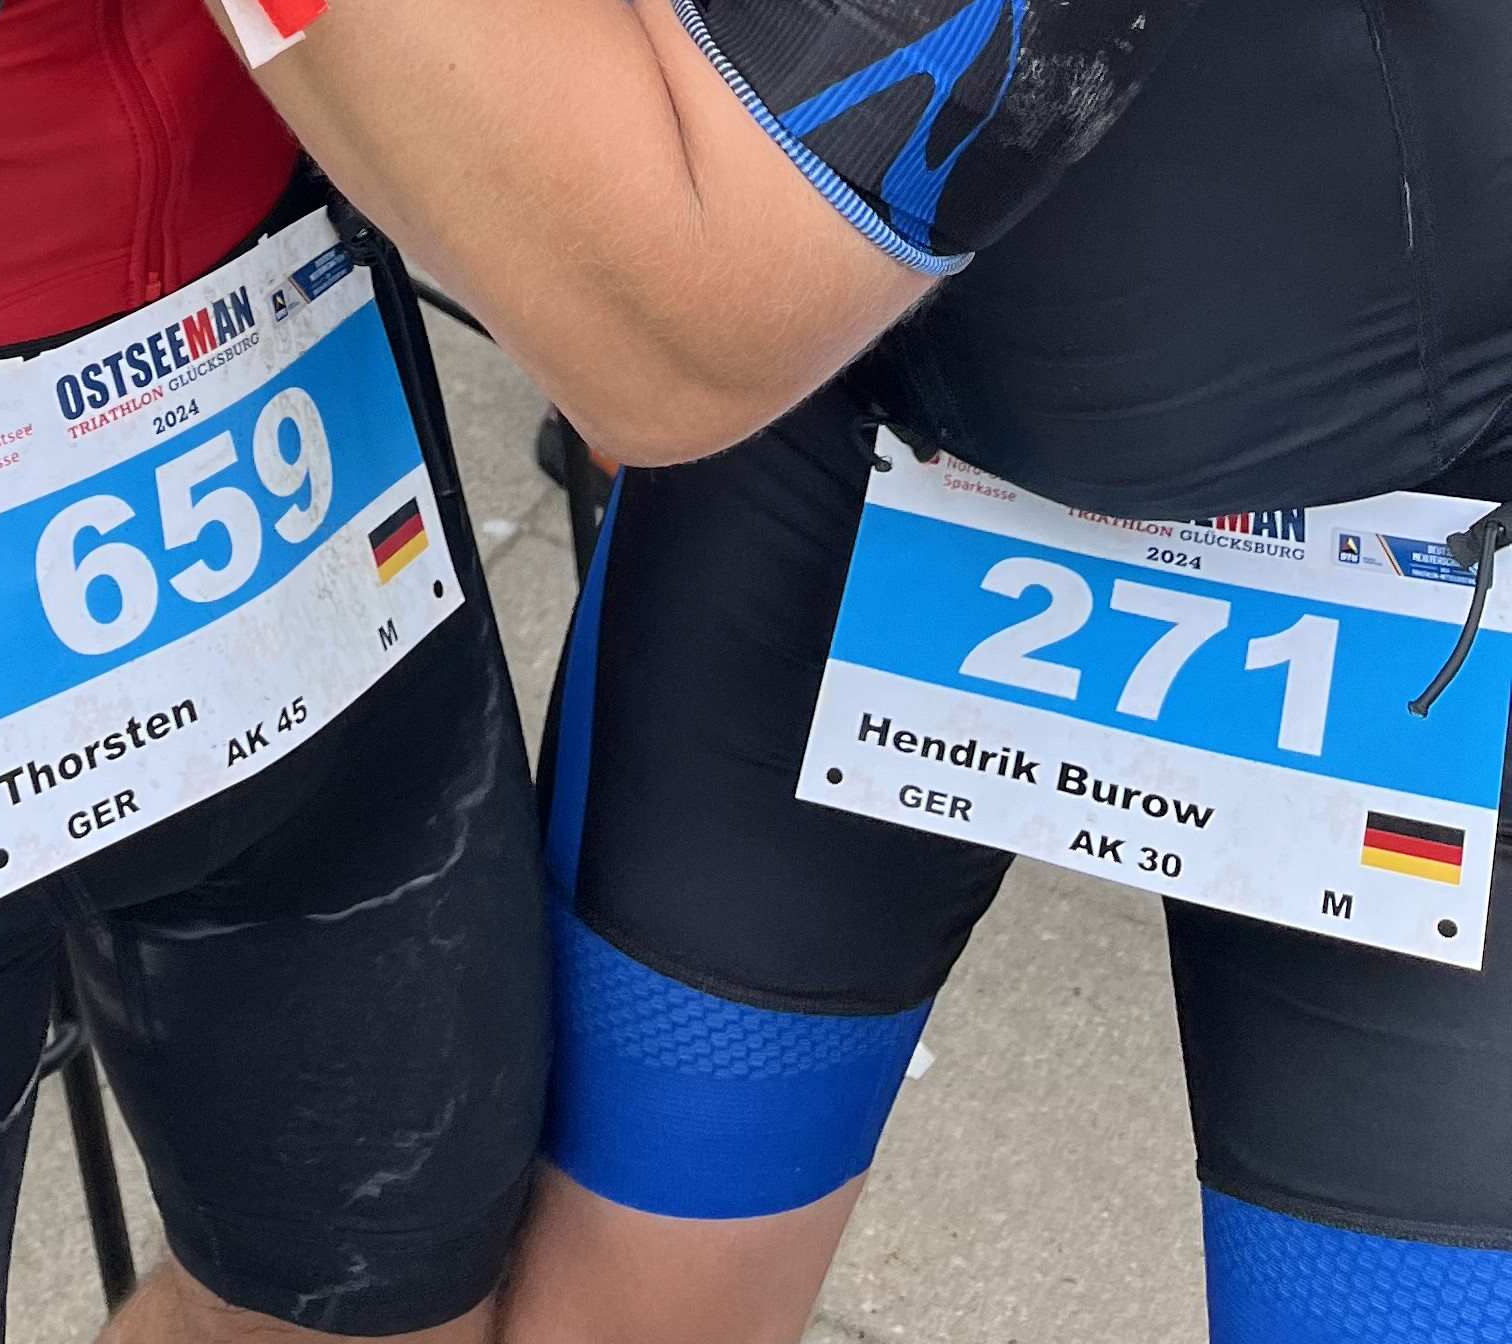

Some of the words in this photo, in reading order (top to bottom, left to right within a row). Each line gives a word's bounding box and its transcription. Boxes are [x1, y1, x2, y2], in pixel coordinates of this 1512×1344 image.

[55, 285, 256, 421] OSTSEEMAN
[67, 384, 165, 440] TRIATHLON
[168, 331, 261, 393] GLÜCKSBURG
[152, 398, 201, 435] 2024
[35, 386, 332, 656] 659
[943, 474, 1017, 503] Sparkasse
[1179, 529, 1306, 561] GLÜCKSBURG
[1147, 546, 1202, 571] 2024
[958, 555, 1340, 758] 271
[67, 788, 141, 841] GER
[226, 721, 270, 768] AK
[277, 695, 309, 733] 45
[377, 617, 399, 651] M
[856, 712, 1042, 785] Hendrik
[1055, 759, 1216, 830] Burow
[897, 783, 974, 823] GER
[1068, 829, 1123, 864] AK
[1138, 845, 1183, 879] 30
[1320, 888, 1354, 920] M
